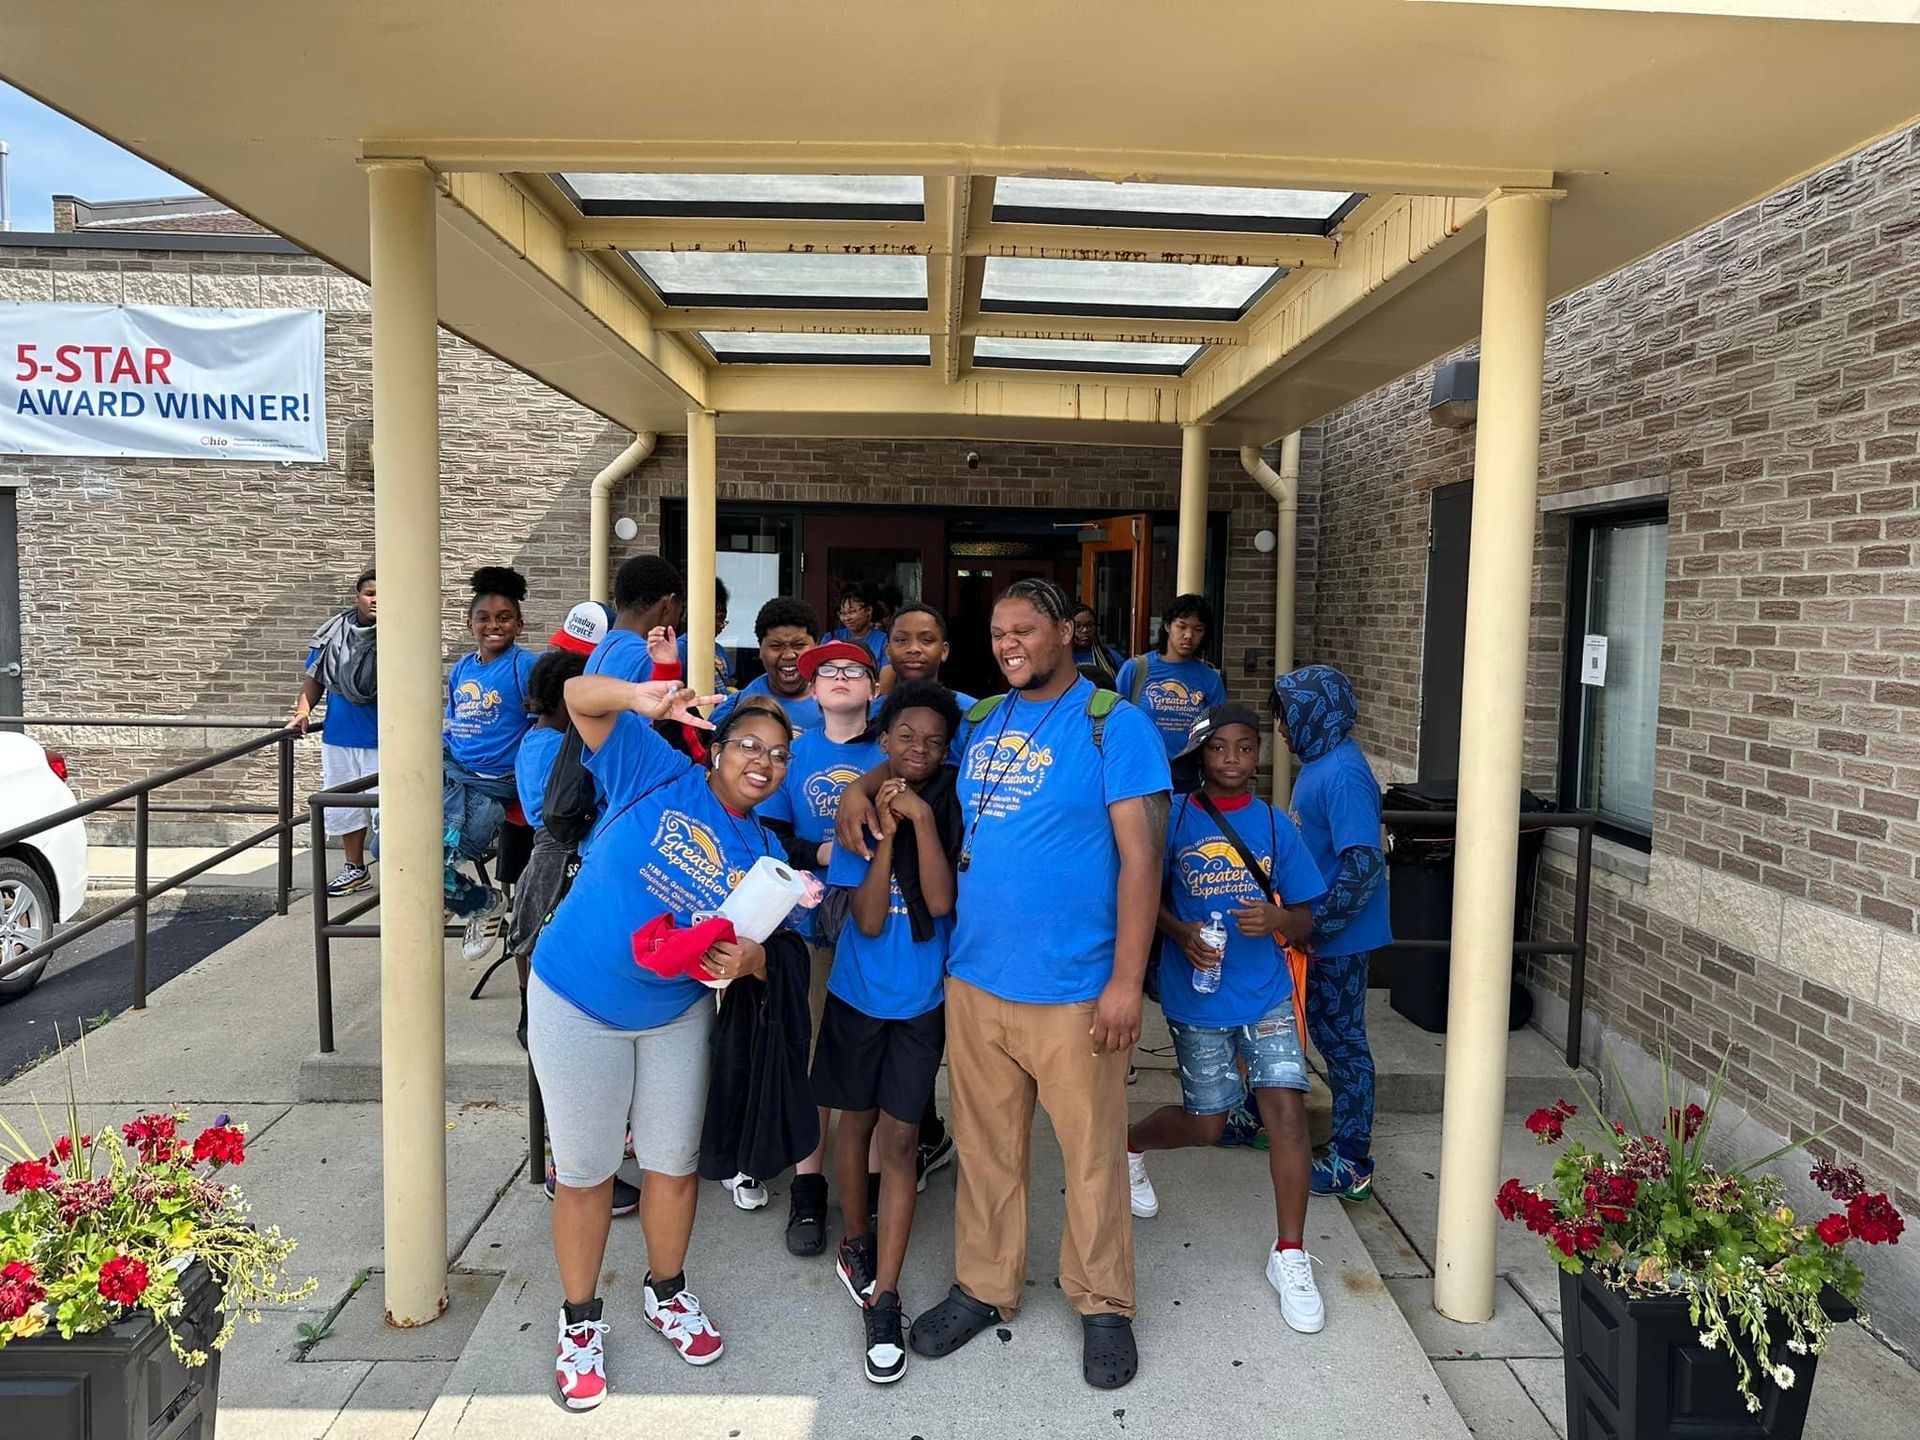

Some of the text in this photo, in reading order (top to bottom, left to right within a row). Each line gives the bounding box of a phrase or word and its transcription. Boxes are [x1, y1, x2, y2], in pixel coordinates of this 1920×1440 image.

[16, 344, 172, 385] 5-STAR
[16, 388, 311, 422] AWARD WINNER!
[201, 435, 228, 446] Ohio
[568, 620, 594, 637] Service
[572, 613, 596, 631] Sunday
[1154, 695, 1190, 706] Greater
[664, 833, 725, 878] Greater
[658, 843, 728, 899] Expectation
[1187, 868, 1248, 887] Greater
[1191, 880, 1257, 899] Expectatio
